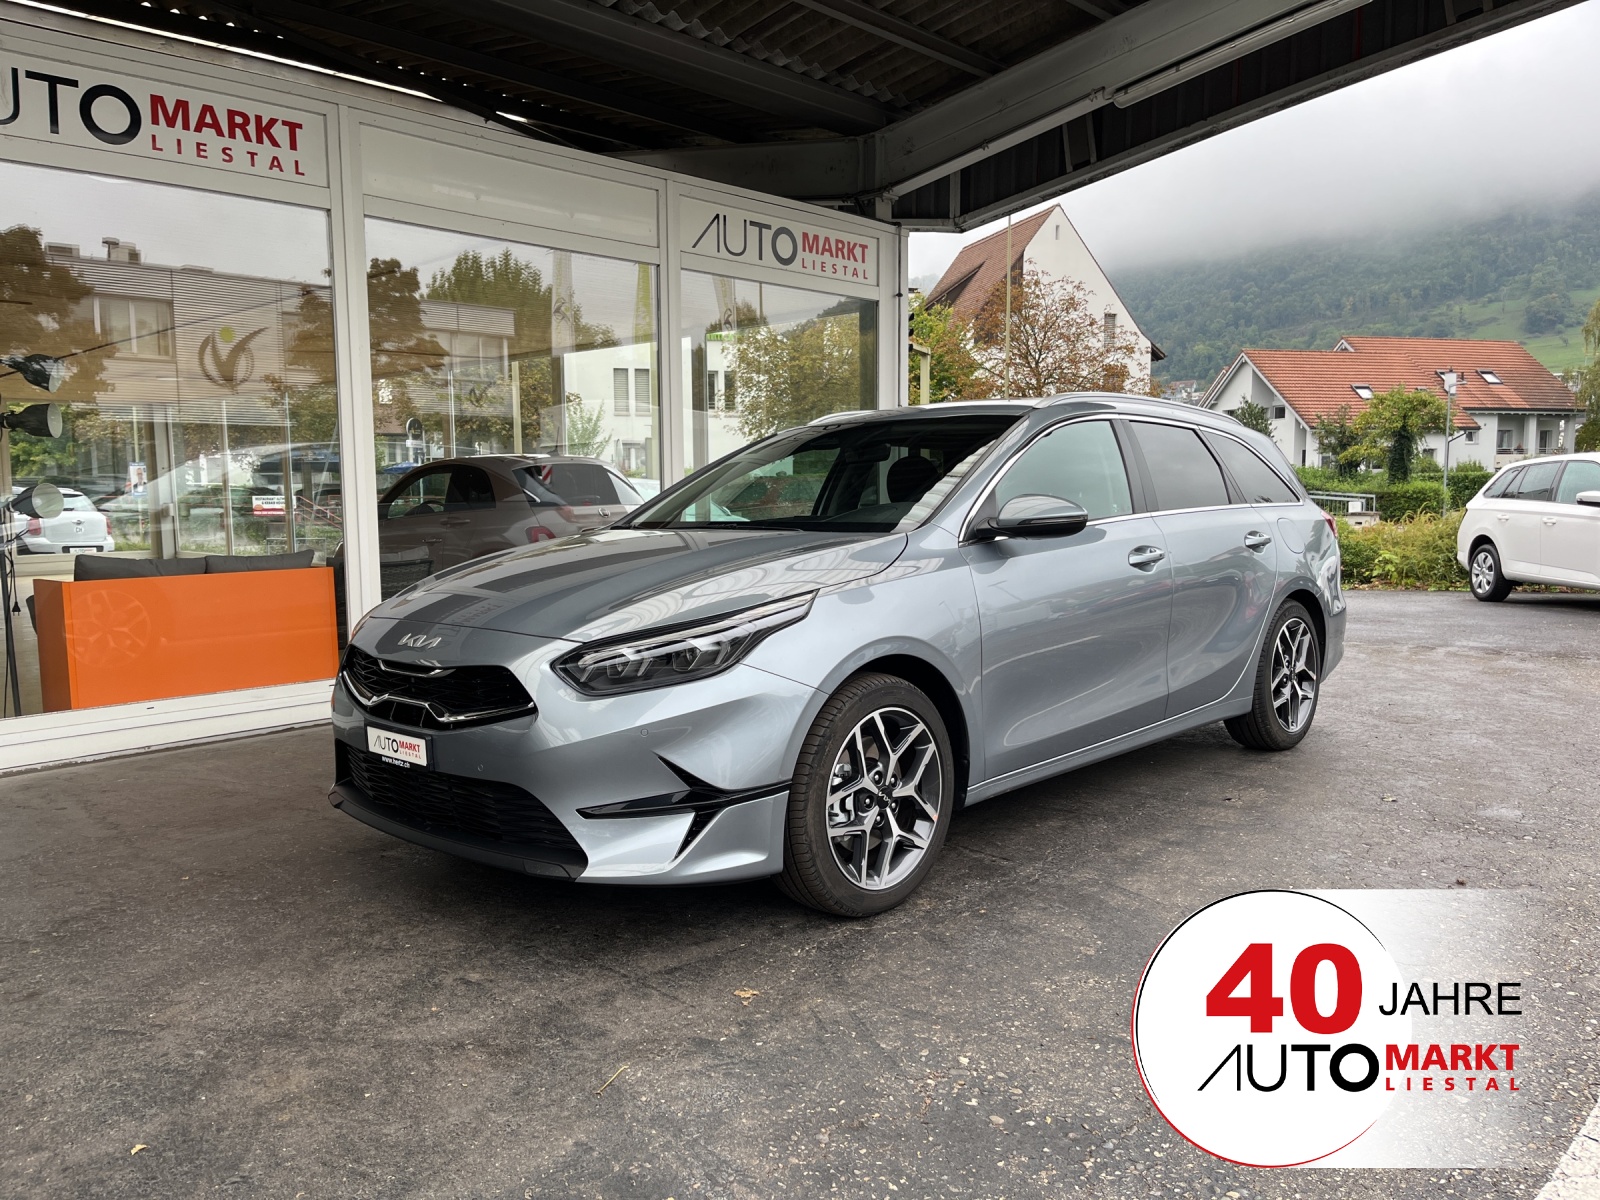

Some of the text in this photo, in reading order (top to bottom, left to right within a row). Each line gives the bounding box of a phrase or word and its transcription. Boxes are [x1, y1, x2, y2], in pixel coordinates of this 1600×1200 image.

[149, 94, 303, 152] MARKT
[151, 134, 305, 177] LIESTAL
[692, 213, 869, 266] AUTO MARKT
[801, 257, 869, 280] LIESTAL
[373, 735, 420, 753] AUTO MARKT
[400, 750, 421, 759] LIESTAL
